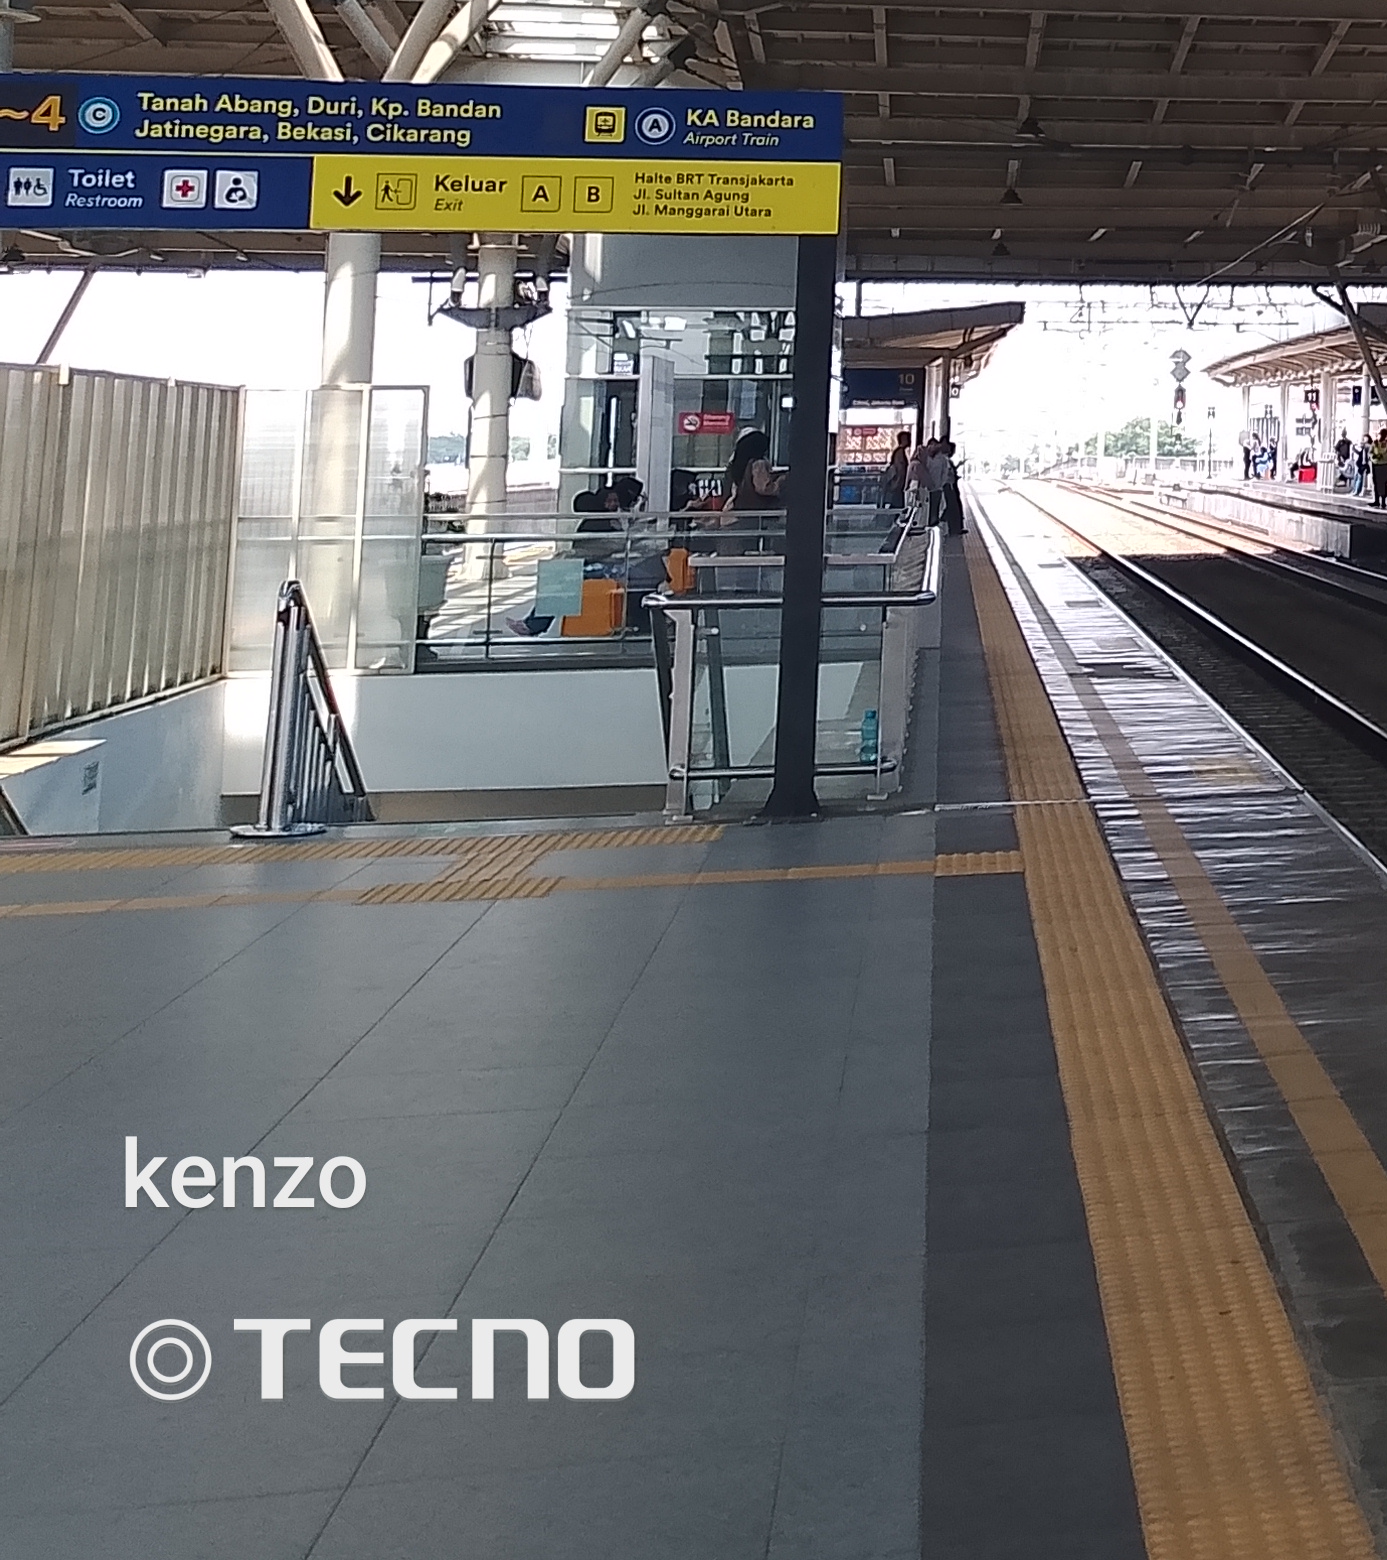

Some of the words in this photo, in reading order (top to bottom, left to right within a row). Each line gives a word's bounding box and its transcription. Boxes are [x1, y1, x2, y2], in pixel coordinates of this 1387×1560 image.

[137, 92, 208, 112] Tanah
[215, 94, 300, 117] Abang,
[307, 96, 364, 118] Duri,
[371, 98, 409, 119] Kp.
[416, 99, 502, 119] Bandan
[686, 109, 717, 127] KA
[726, 109, 815, 129] Bandara
[135, 119, 269, 142] Jatinegara,
[277, 122, 359, 145] Bekasi,
[366, 123, 471, 147] Cikarang
[683, 132, 738, 148] Airport
[743, 133, 779, 146] Train
[68, 169, 136, 188] Toilet
[434, 174, 508, 193] Keluar
[634, 172, 672, 185] Halte
[676, 173, 704, 185] BRT
[708, 173, 794, 188] Transjakarta
[64, 193, 143, 208] Restroom
[531, 186, 550, 202] A
[587, 186, 600, 203] B
[633, 188, 651, 200] Jl.
[655, 189, 700, 201] Sultan
[703, 190, 750, 204] Agung
[433, 198, 464, 212] Exit
[632, 204, 650, 216] Jl.
[654, 205, 730, 219] Manggarai
[734, 206, 772, 218] Utara
[899, 373, 915, 385] 10
[1307, 392, 1317, 402] 11
